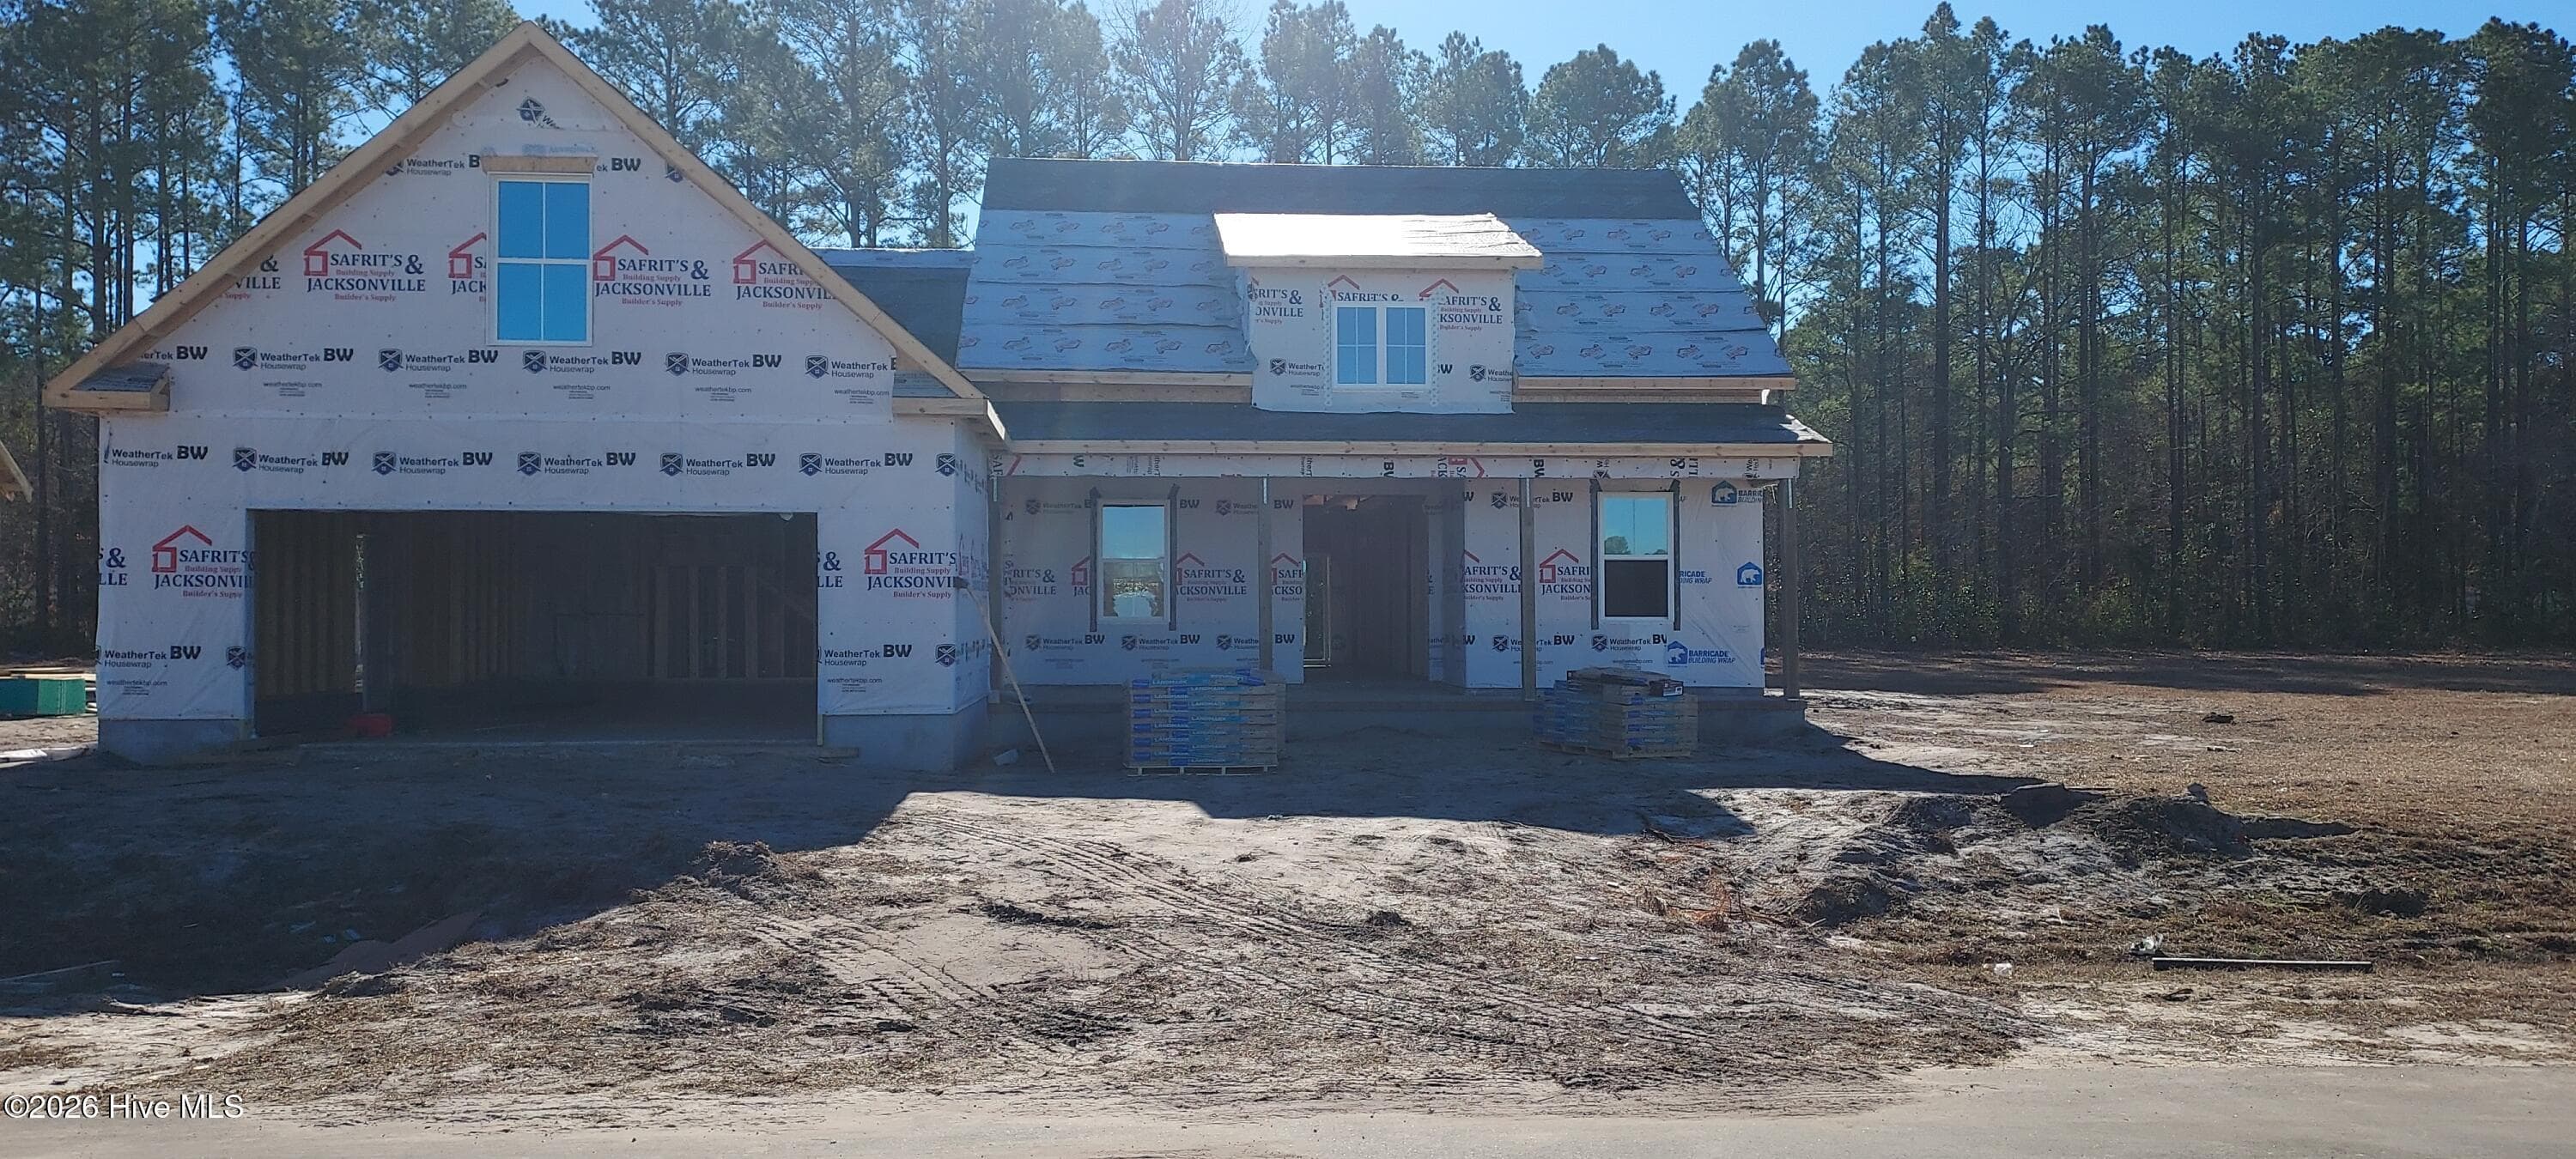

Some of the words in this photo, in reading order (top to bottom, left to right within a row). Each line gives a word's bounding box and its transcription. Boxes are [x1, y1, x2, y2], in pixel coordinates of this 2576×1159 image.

[406, 158, 465, 168] WeatherTek
[611, 157, 641, 172] BW
[330, 252, 402, 268] SAFRIT'S
[404, 253, 424, 275] &
[617, 258, 689, 272] SAFRIT'S
[690, 259, 709, 280] &
[335, 269, 368, 277] Building
[369, 269, 395, 279] Supply
[623, 273, 653, 282] Building
[654, 273, 682, 283] Supply
[307, 276, 426, 292] JACKSONVILLE
[763, 276, 795, 285] Building
[594, 282, 712, 298] JACKSONVILLE
[736, 285, 839, 300] JACKSONVIL
[334, 293, 369, 301] Builder's
[370, 293, 397, 302] Supply
[1288, 289, 1303, 305] &
[1337, 291, 1388, 302] SAFRIT'S
[657, 299, 683, 307] Supply
[762, 300, 795, 309] Builder's
[797, 301, 823, 311] Supply
[1438, 295, 1487, 306] AFRIT'S
[1488, 296, 1502, 312] &
[176, 345, 208, 361] BW
[260, 351, 320, 362] WeatherTek
[323, 347, 354, 361] BW
[405, 354, 465, 364] WeatherTek
[468, 349, 498, 364] BW
[549, 355, 609, 366] WeatherTek
[611, 351, 641, 365] BW
[260, 361, 307, 371] Housewrap
[691, 357, 750, 368] WeatherTek
[752, 354, 782, 368] BW
[830, 361, 888, 372] WeatherTek
[405, 364, 451, 373] Housewrap
[550, 365, 594, 374] Housewrap
[691, 367, 736, 378] Housewrap
[830, 370, 874, 379] Housewrap
[112, 448, 173, 460] WeatherTek
[176, 445, 208, 460] BW
[112, 458, 159, 468] Housewrap
[258, 454, 318, 467] WeatherTek
[321, 452, 349, 466] BW
[399, 457, 459, 467] WeatherTek
[462, 452, 493, 466] BW
[544, 457, 603, 467] WeatherTek
[606, 452, 636, 466] BW
[686, 458, 744, 469] WeatherTek
[745, 453, 776, 467] BW
[824, 458, 882, 468] WeatherTek
[884, 452, 913, 467] BW
[258, 464, 304, 474] Housewrap
[399, 466, 446, 475] Housewrap
[544, 466, 589, 475] Housewrap
[686, 467, 730, 476] Housewrap
[824, 467, 868, 476] Housewrap
[1552, 491, 1574, 503] BW
[1179, 499, 1200, 509] BW
[1273, 499, 1294, 510] BW
[106, 547, 126, 568] &
[179, 549, 248, 563] SAFRIT'S
[823, 551, 841, 572] &
[890, 552, 957, 565] SAFRIT'S
[185, 565, 218, 574] Building
[894, 567, 925, 575] Building
[926, 567, 951, 576] Supply
[1509, 566, 1522, 581] &
[1042, 569, 1055, 583] &
[1183, 569, 1232, 579] SAFRIT'S
[1232, 568, 1246, 584] &
[182, 590, 218, 598] Builder's
[893, 591, 926, 599] Builder's
[927, 591, 952, 600] Supply
[1084, 634, 1106, 645] BW
[1180, 634, 1200, 645] BW
[1274, 634, 1296, 645] BW
[1553, 634, 1575, 646] BW
[104, 650, 167, 661] WeatherTek
[170, 646, 201, 660] BW
[824, 648, 881, 658] WeatherTek
[883, 644, 913, 658] BW
[104, 660, 152, 669] Housewrap
[824, 658, 867, 667] Housewrap
